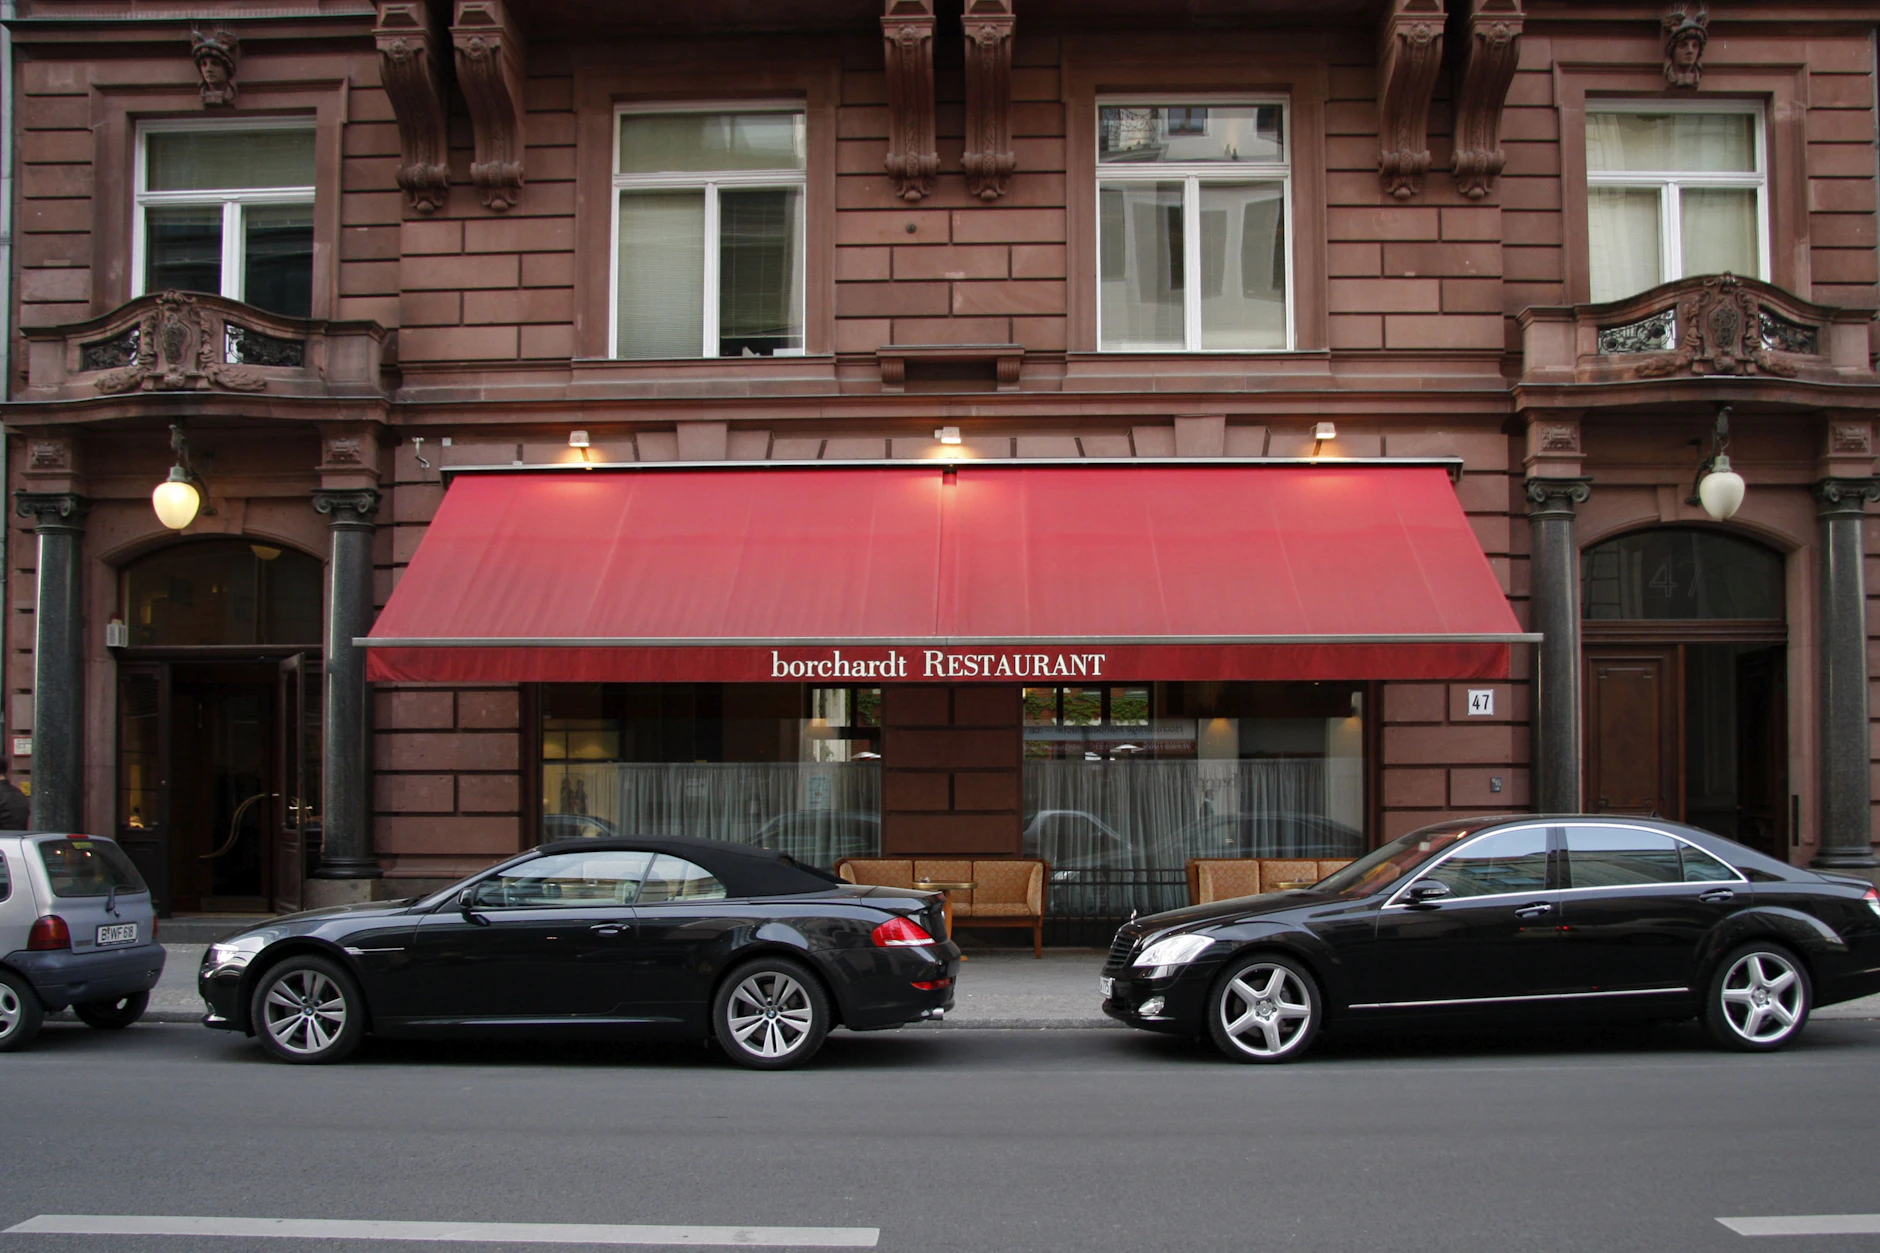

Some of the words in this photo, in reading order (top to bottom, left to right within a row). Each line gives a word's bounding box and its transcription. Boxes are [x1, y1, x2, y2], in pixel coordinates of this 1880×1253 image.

[771, 650, 907, 677] borchardt
[922, 650, 1106, 677] RESTAURANT
[1472, 694, 1490, 710] 47
